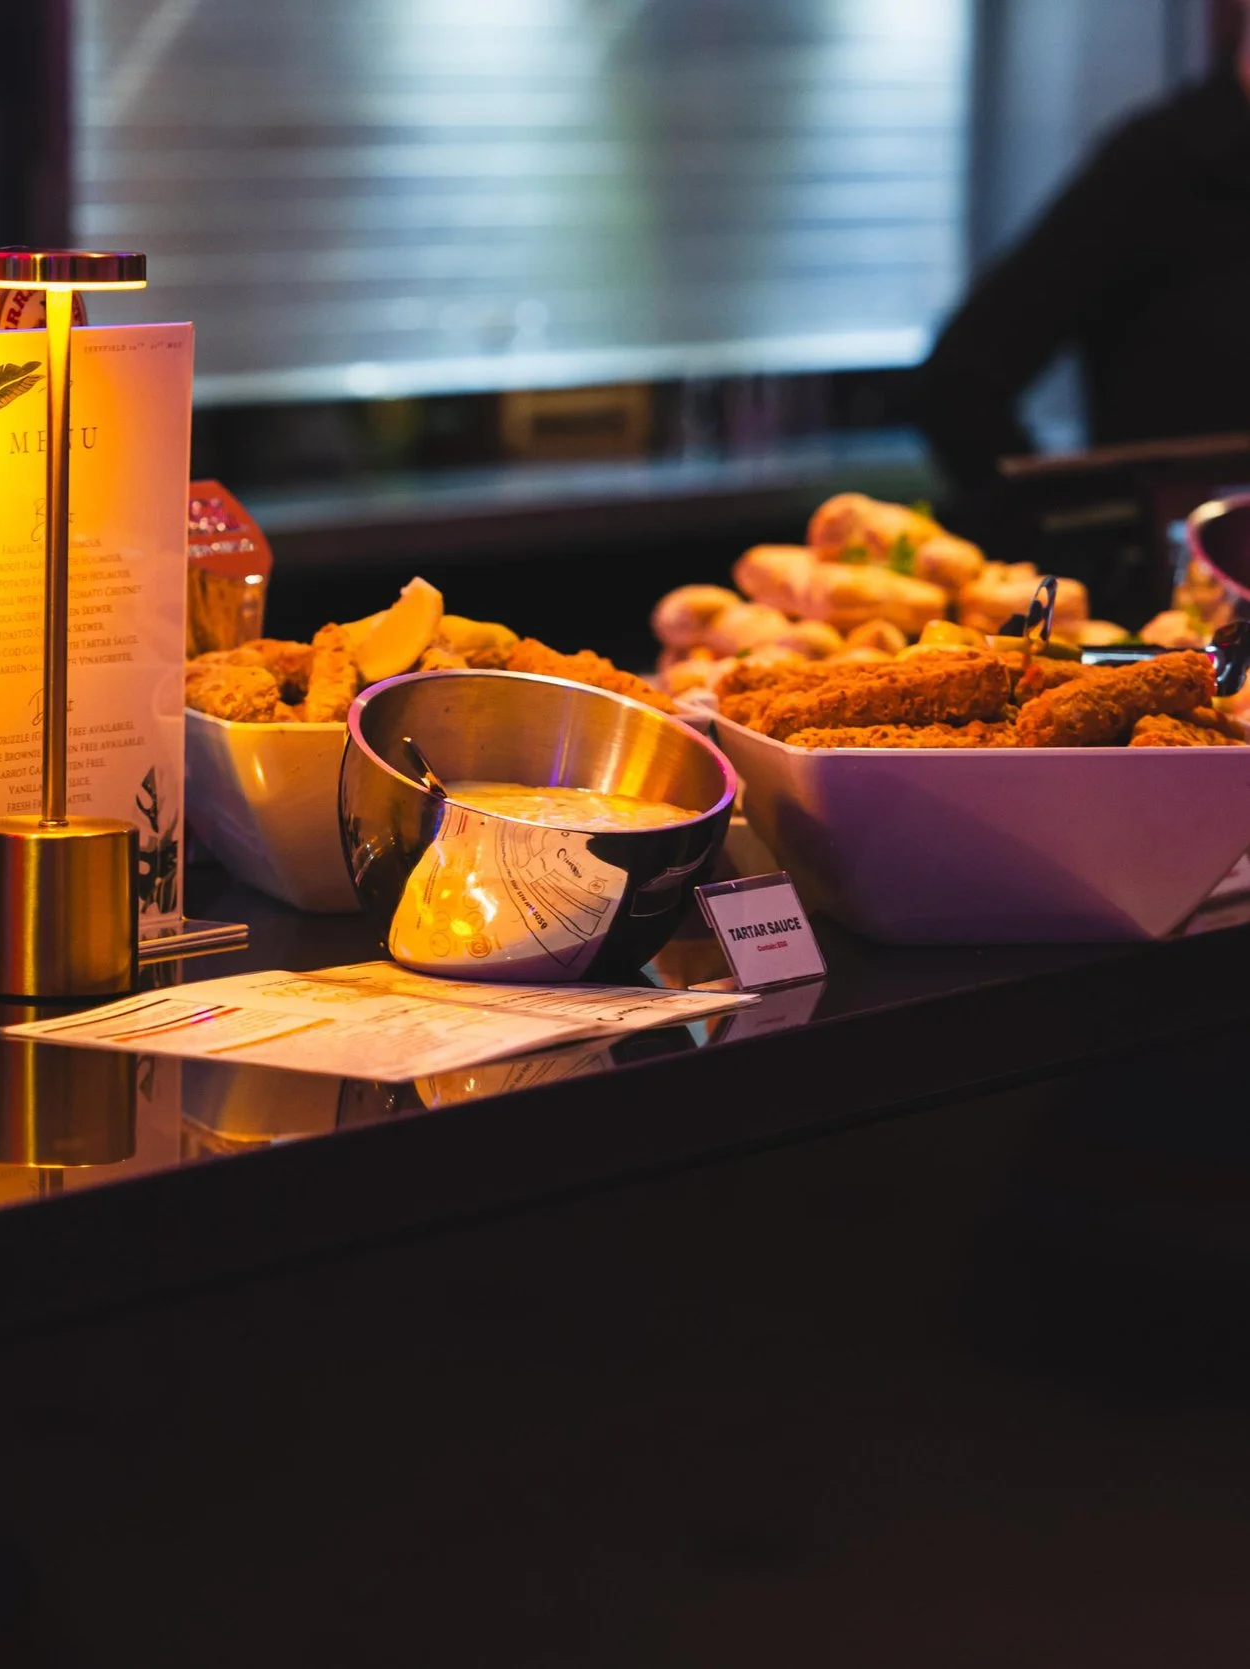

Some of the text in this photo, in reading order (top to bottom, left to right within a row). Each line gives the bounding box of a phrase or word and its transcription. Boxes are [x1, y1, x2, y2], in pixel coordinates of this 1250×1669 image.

[9, 426, 99, 455] MEU
[6, 800, 31, 812] FRESH
[728, 917, 802, 941] TARTAR SAUCE
